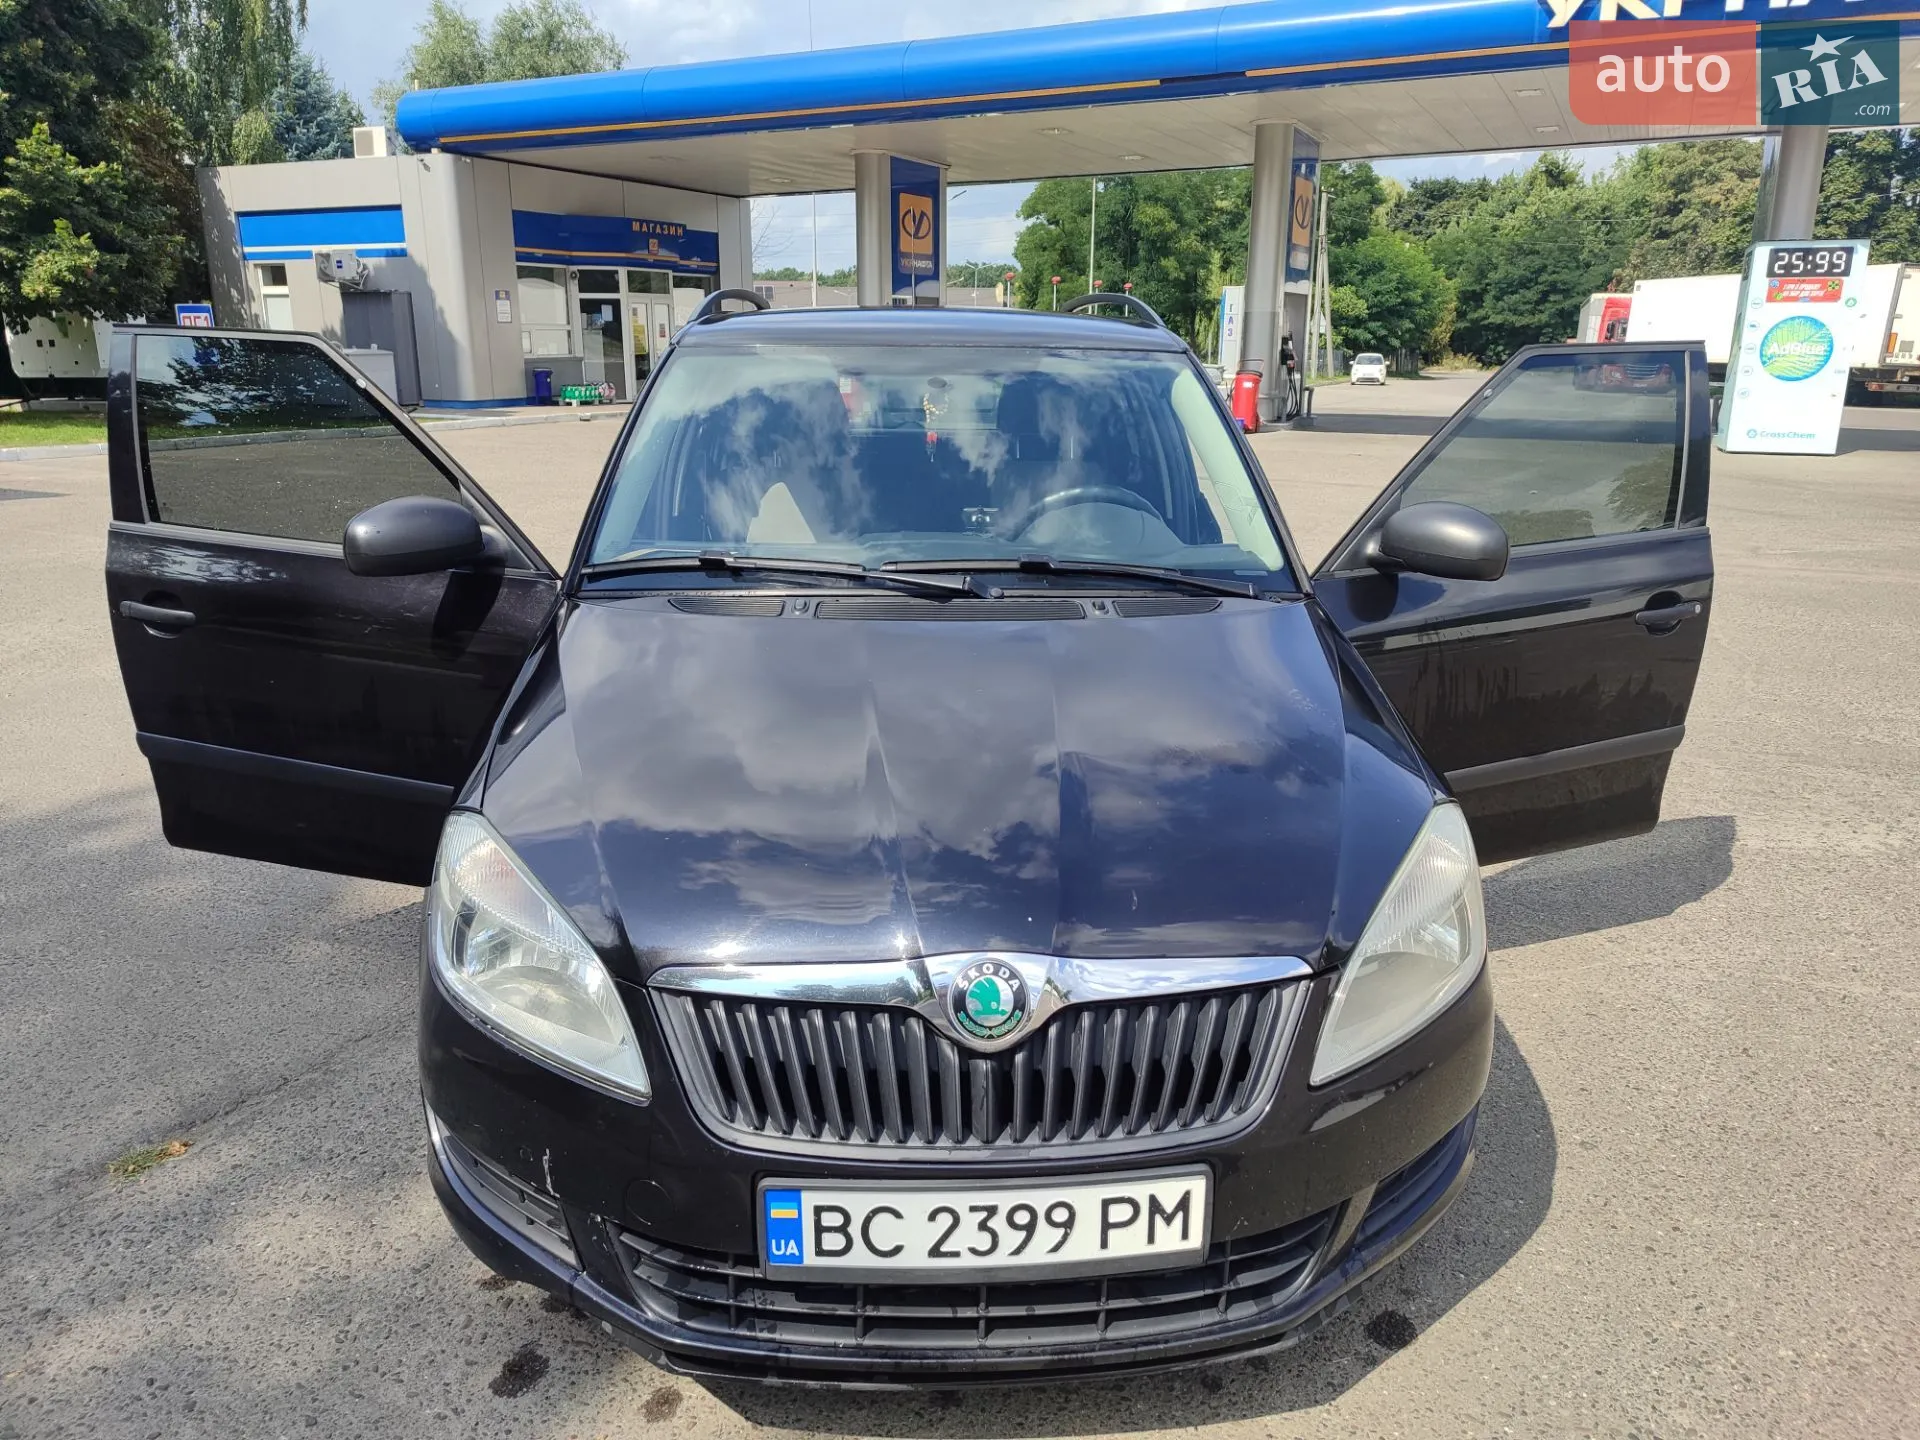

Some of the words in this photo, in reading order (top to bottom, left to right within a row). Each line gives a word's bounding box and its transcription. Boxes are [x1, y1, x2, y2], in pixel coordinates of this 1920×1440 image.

[632, 221, 683, 237] МАГАЗИН
[812, 1204, 905, 1258] BC
[927, 1200, 1077, 1259] 2399
[1100, 1188, 1193, 1250] PM
[771, 1239, 799, 1257] UA
